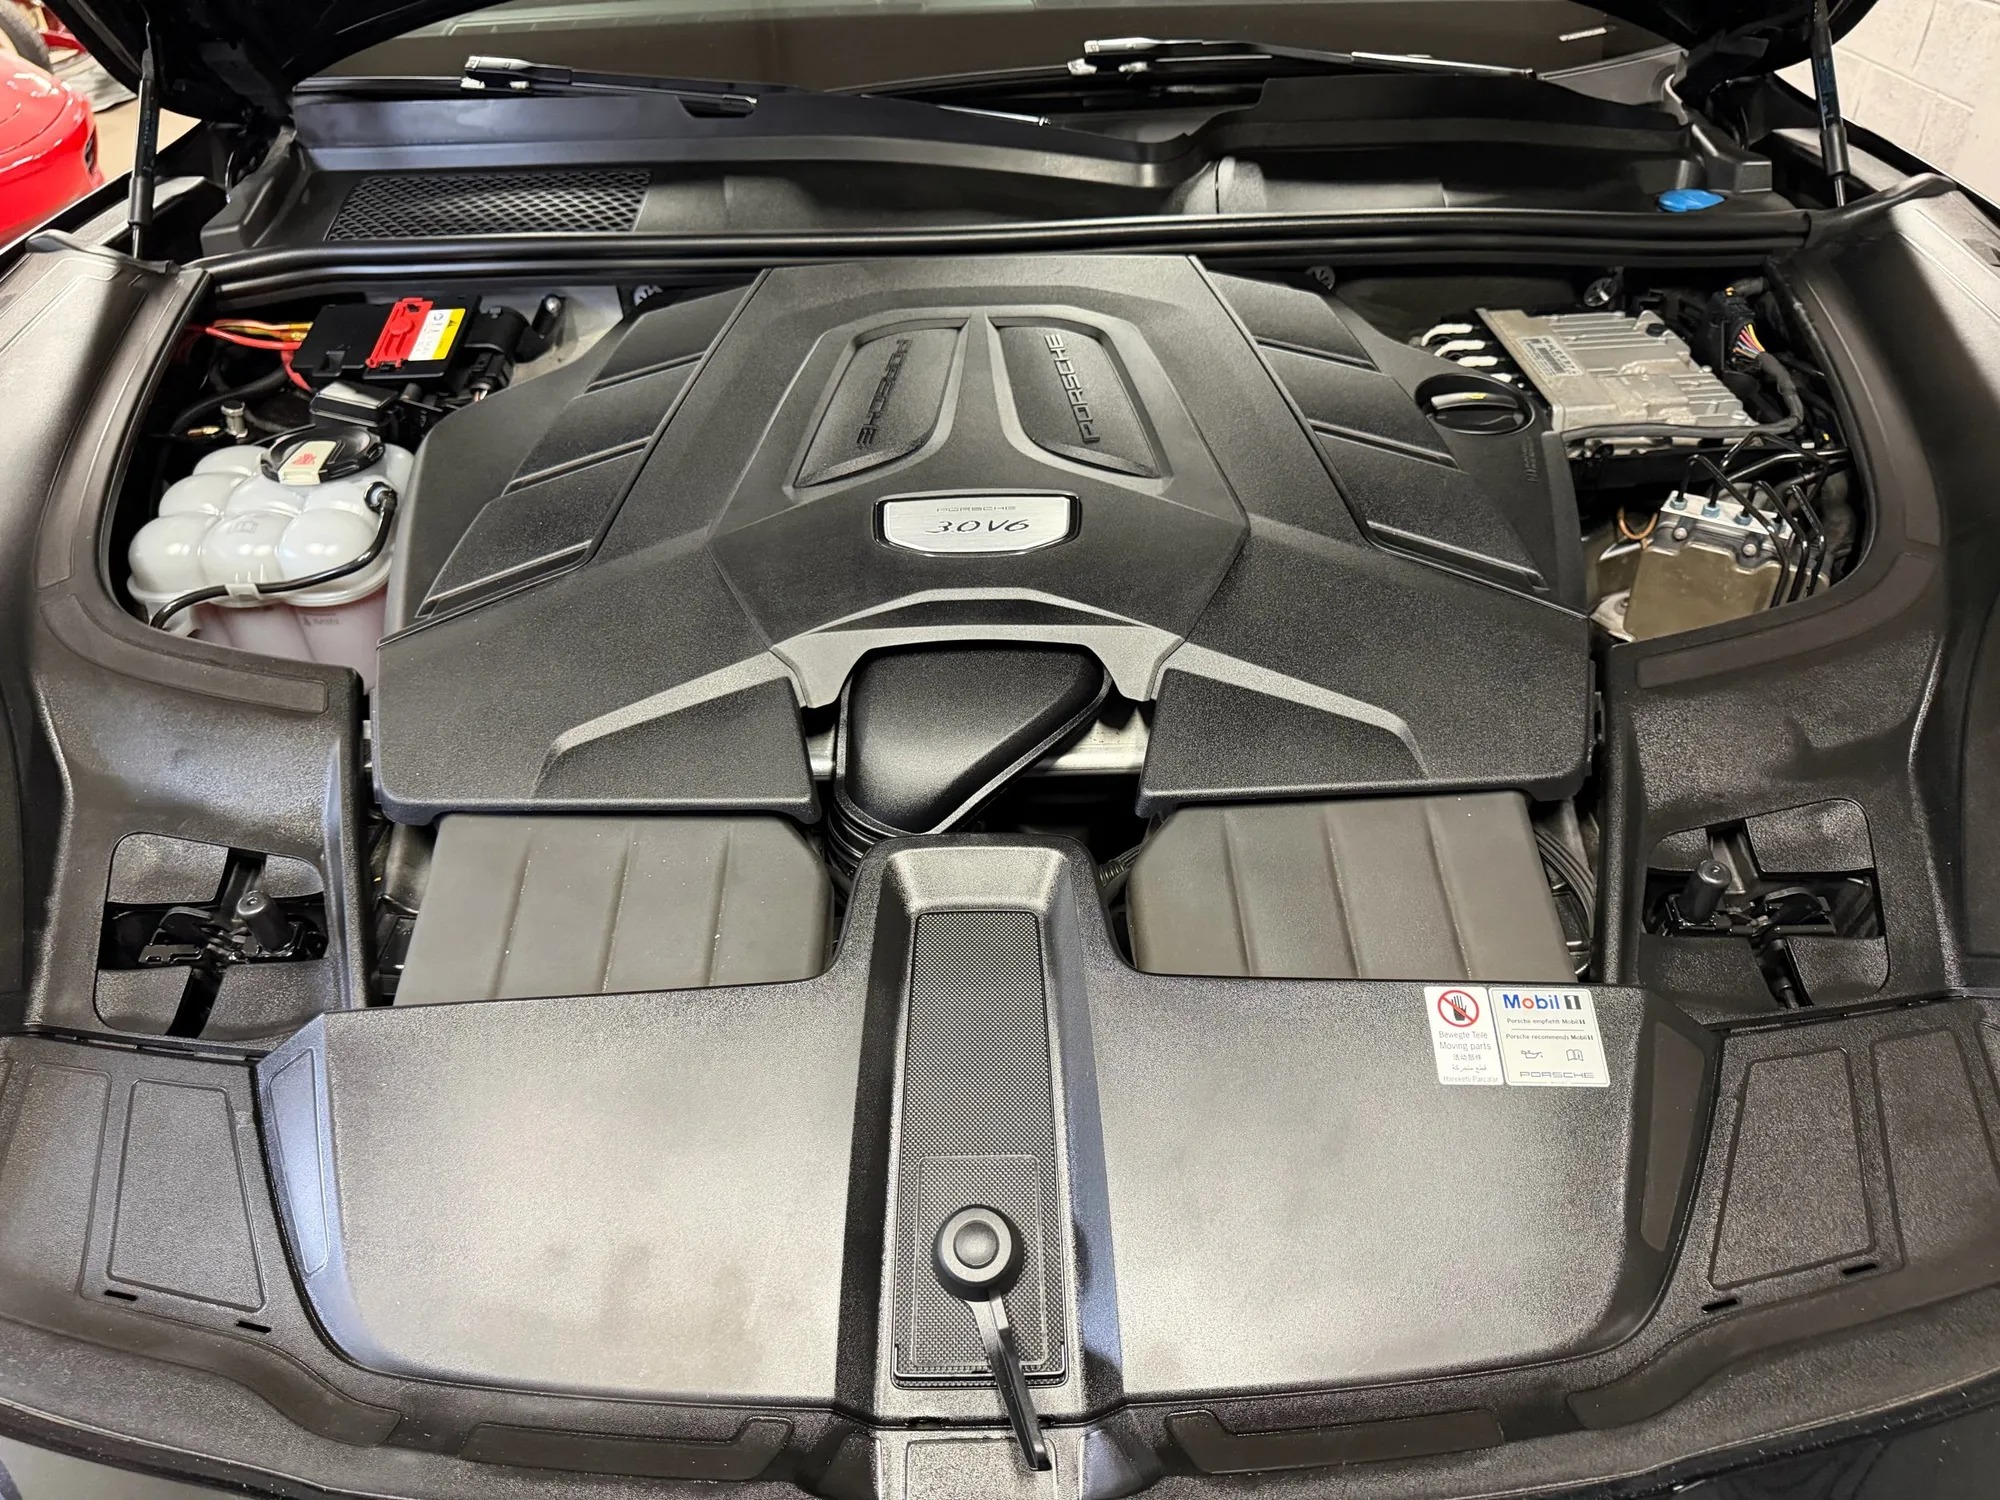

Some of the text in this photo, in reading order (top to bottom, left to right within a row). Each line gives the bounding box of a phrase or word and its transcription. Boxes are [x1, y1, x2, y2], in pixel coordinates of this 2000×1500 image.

[856, 338, 912, 447] PORSCHE
[1045, 334, 1100, 443] PORSCHE
[987, 518, 1030, 533] V6
[1502, 994, 1582, 1010] Mobil 1
[1439, 1031, 1488, 1040] Bewegte Teile
[1440, 1041, 1491, 1052] Moving parts
[1520, 1071, 1595, 1079] PORSCHE
